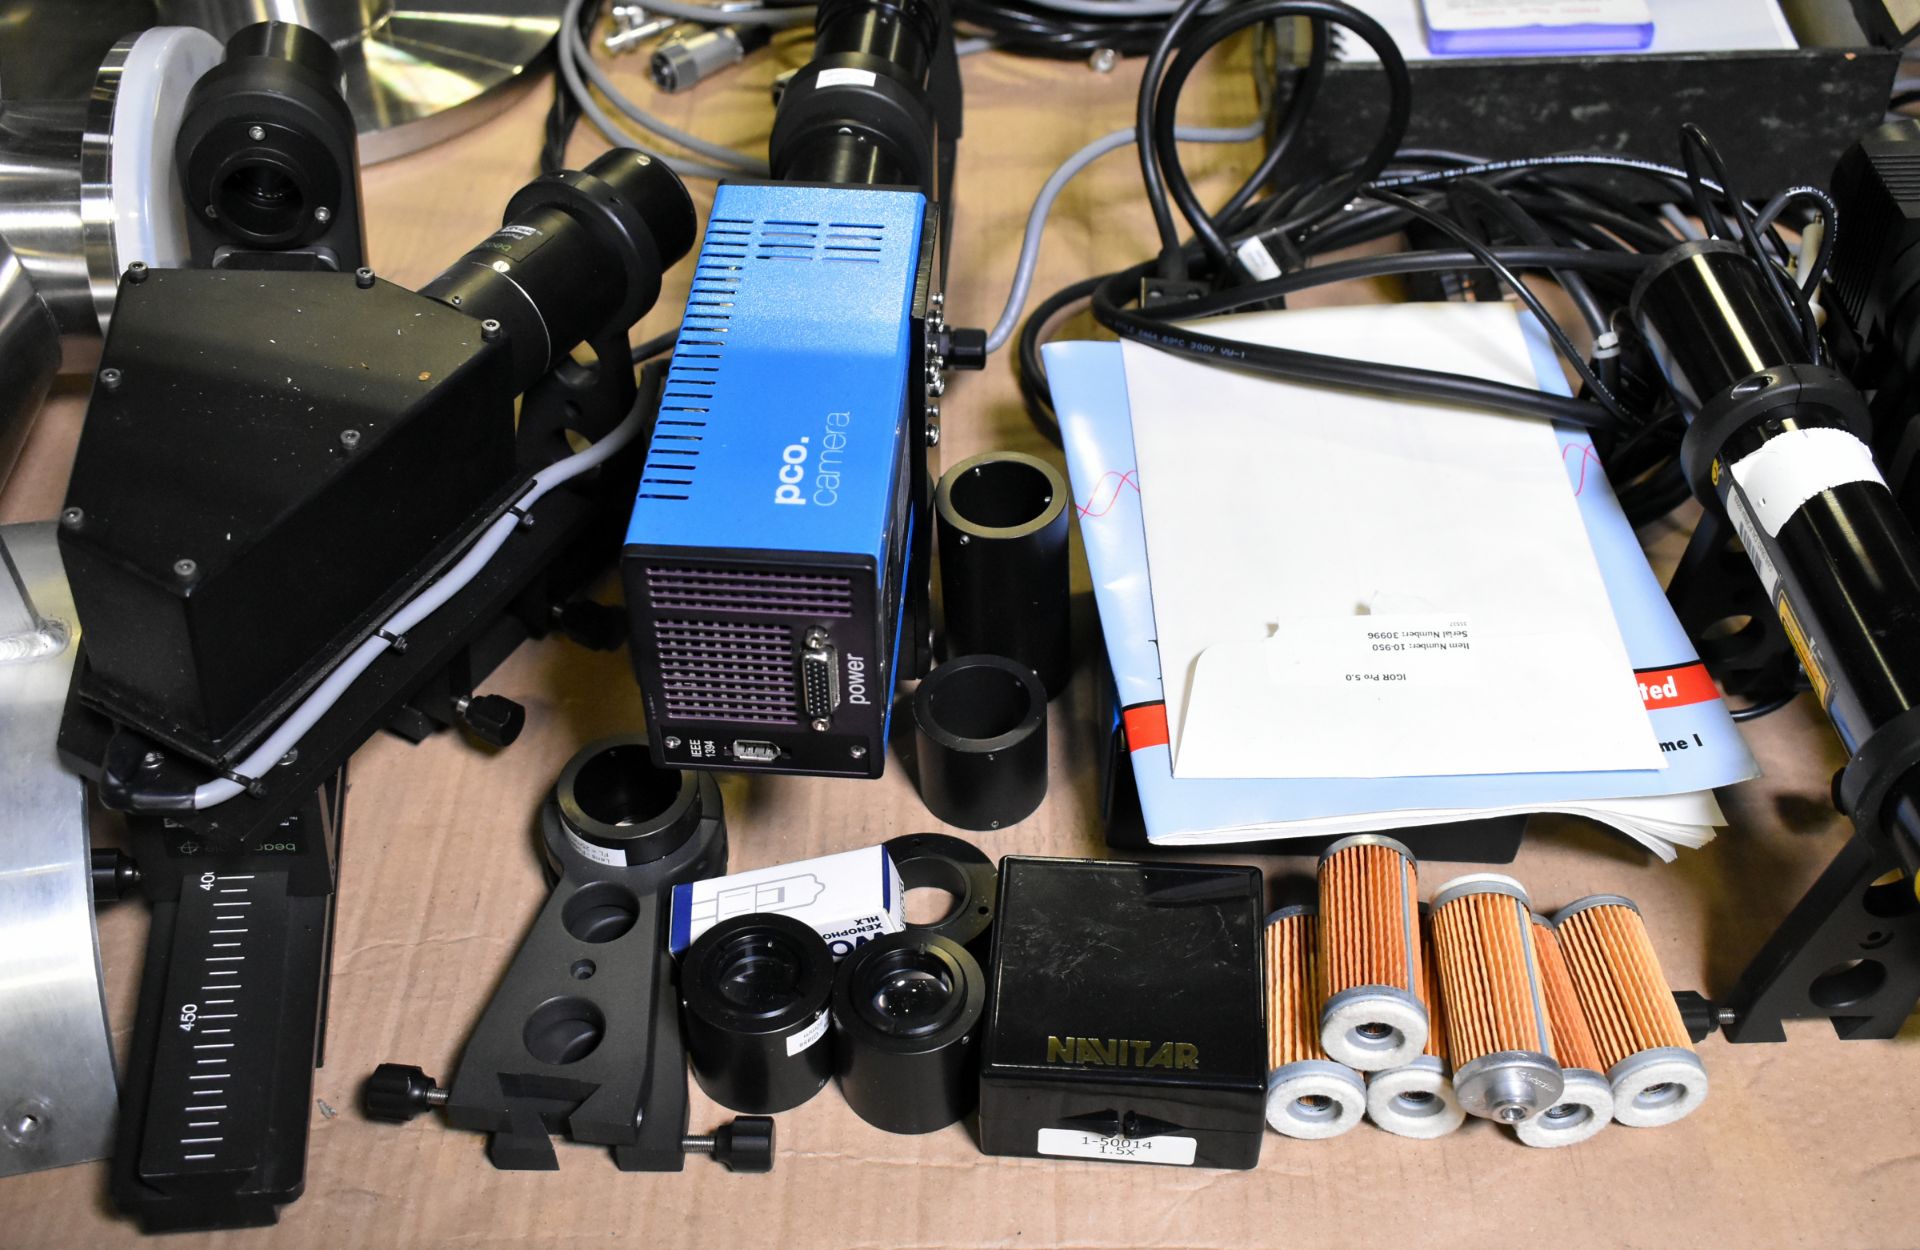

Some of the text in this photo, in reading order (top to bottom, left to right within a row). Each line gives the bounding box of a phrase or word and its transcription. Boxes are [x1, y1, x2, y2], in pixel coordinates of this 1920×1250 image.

[813, 411, 850, 506] camera
[774, 436, 810, 505] pco.
[1402, 630, 1440, 638] Number:
[1443, 630, 1468, 638] Serial
[1372, 642, 1470, 651] Item Number: 10-950
[847, 653, 871, 705] power
[1345, 673, 1407, 681] IGOR Pro 5.0
[689, 739, 702, 757] IEEE
[704, 740, 716, 757] 1394
[854, 915, 880, 926] HLX
[179, 1004, 198, 1031] 450
[1047, 1035, 1199, 1070] NAVITAR
[1082, 1136, 1153, 1150] 1-50014
[1099, 1146, 1136, 1157] 1.5x
